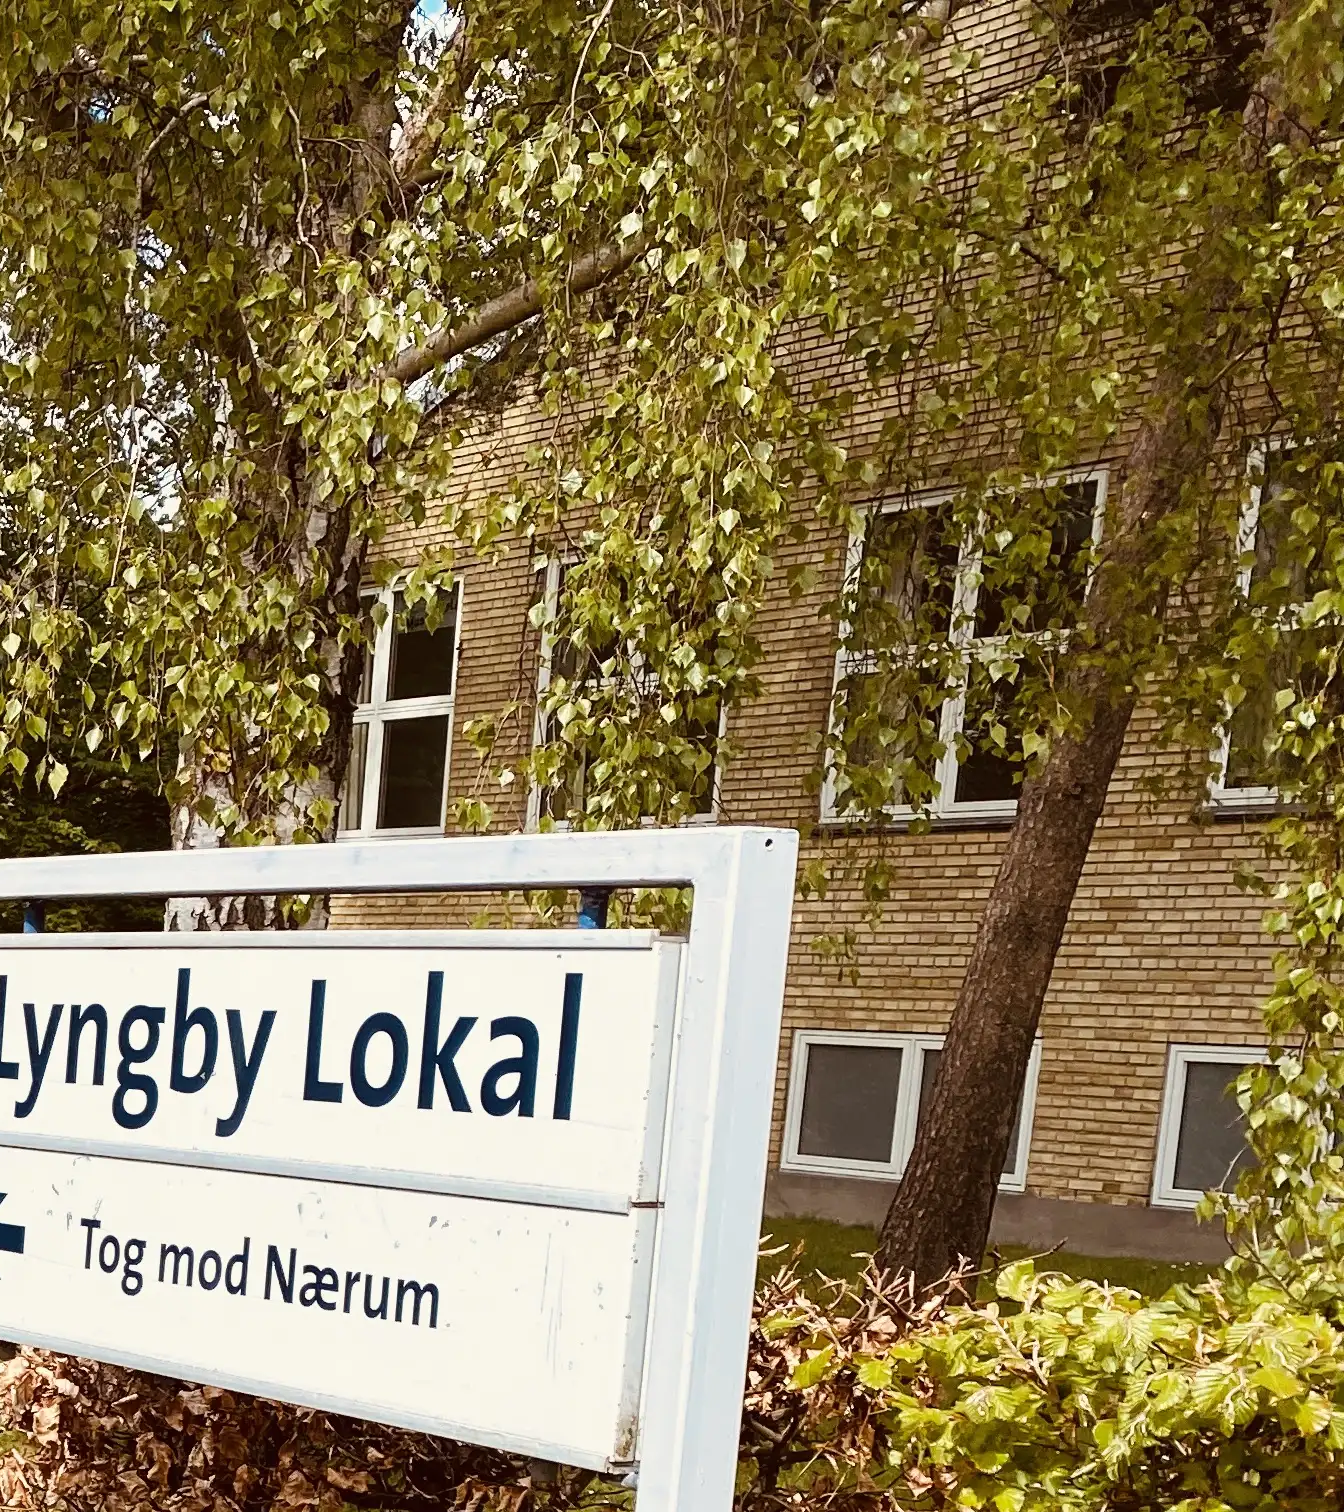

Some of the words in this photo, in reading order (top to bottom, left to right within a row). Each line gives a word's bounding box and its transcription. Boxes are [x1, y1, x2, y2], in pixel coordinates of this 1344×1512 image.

[302, 970, 585, 1121] Lokal
[79, 1216, 148, 1298] Tog
[157, 1235, 252, 1297] mod
[263, 1243, 440, 1330] Nærum
